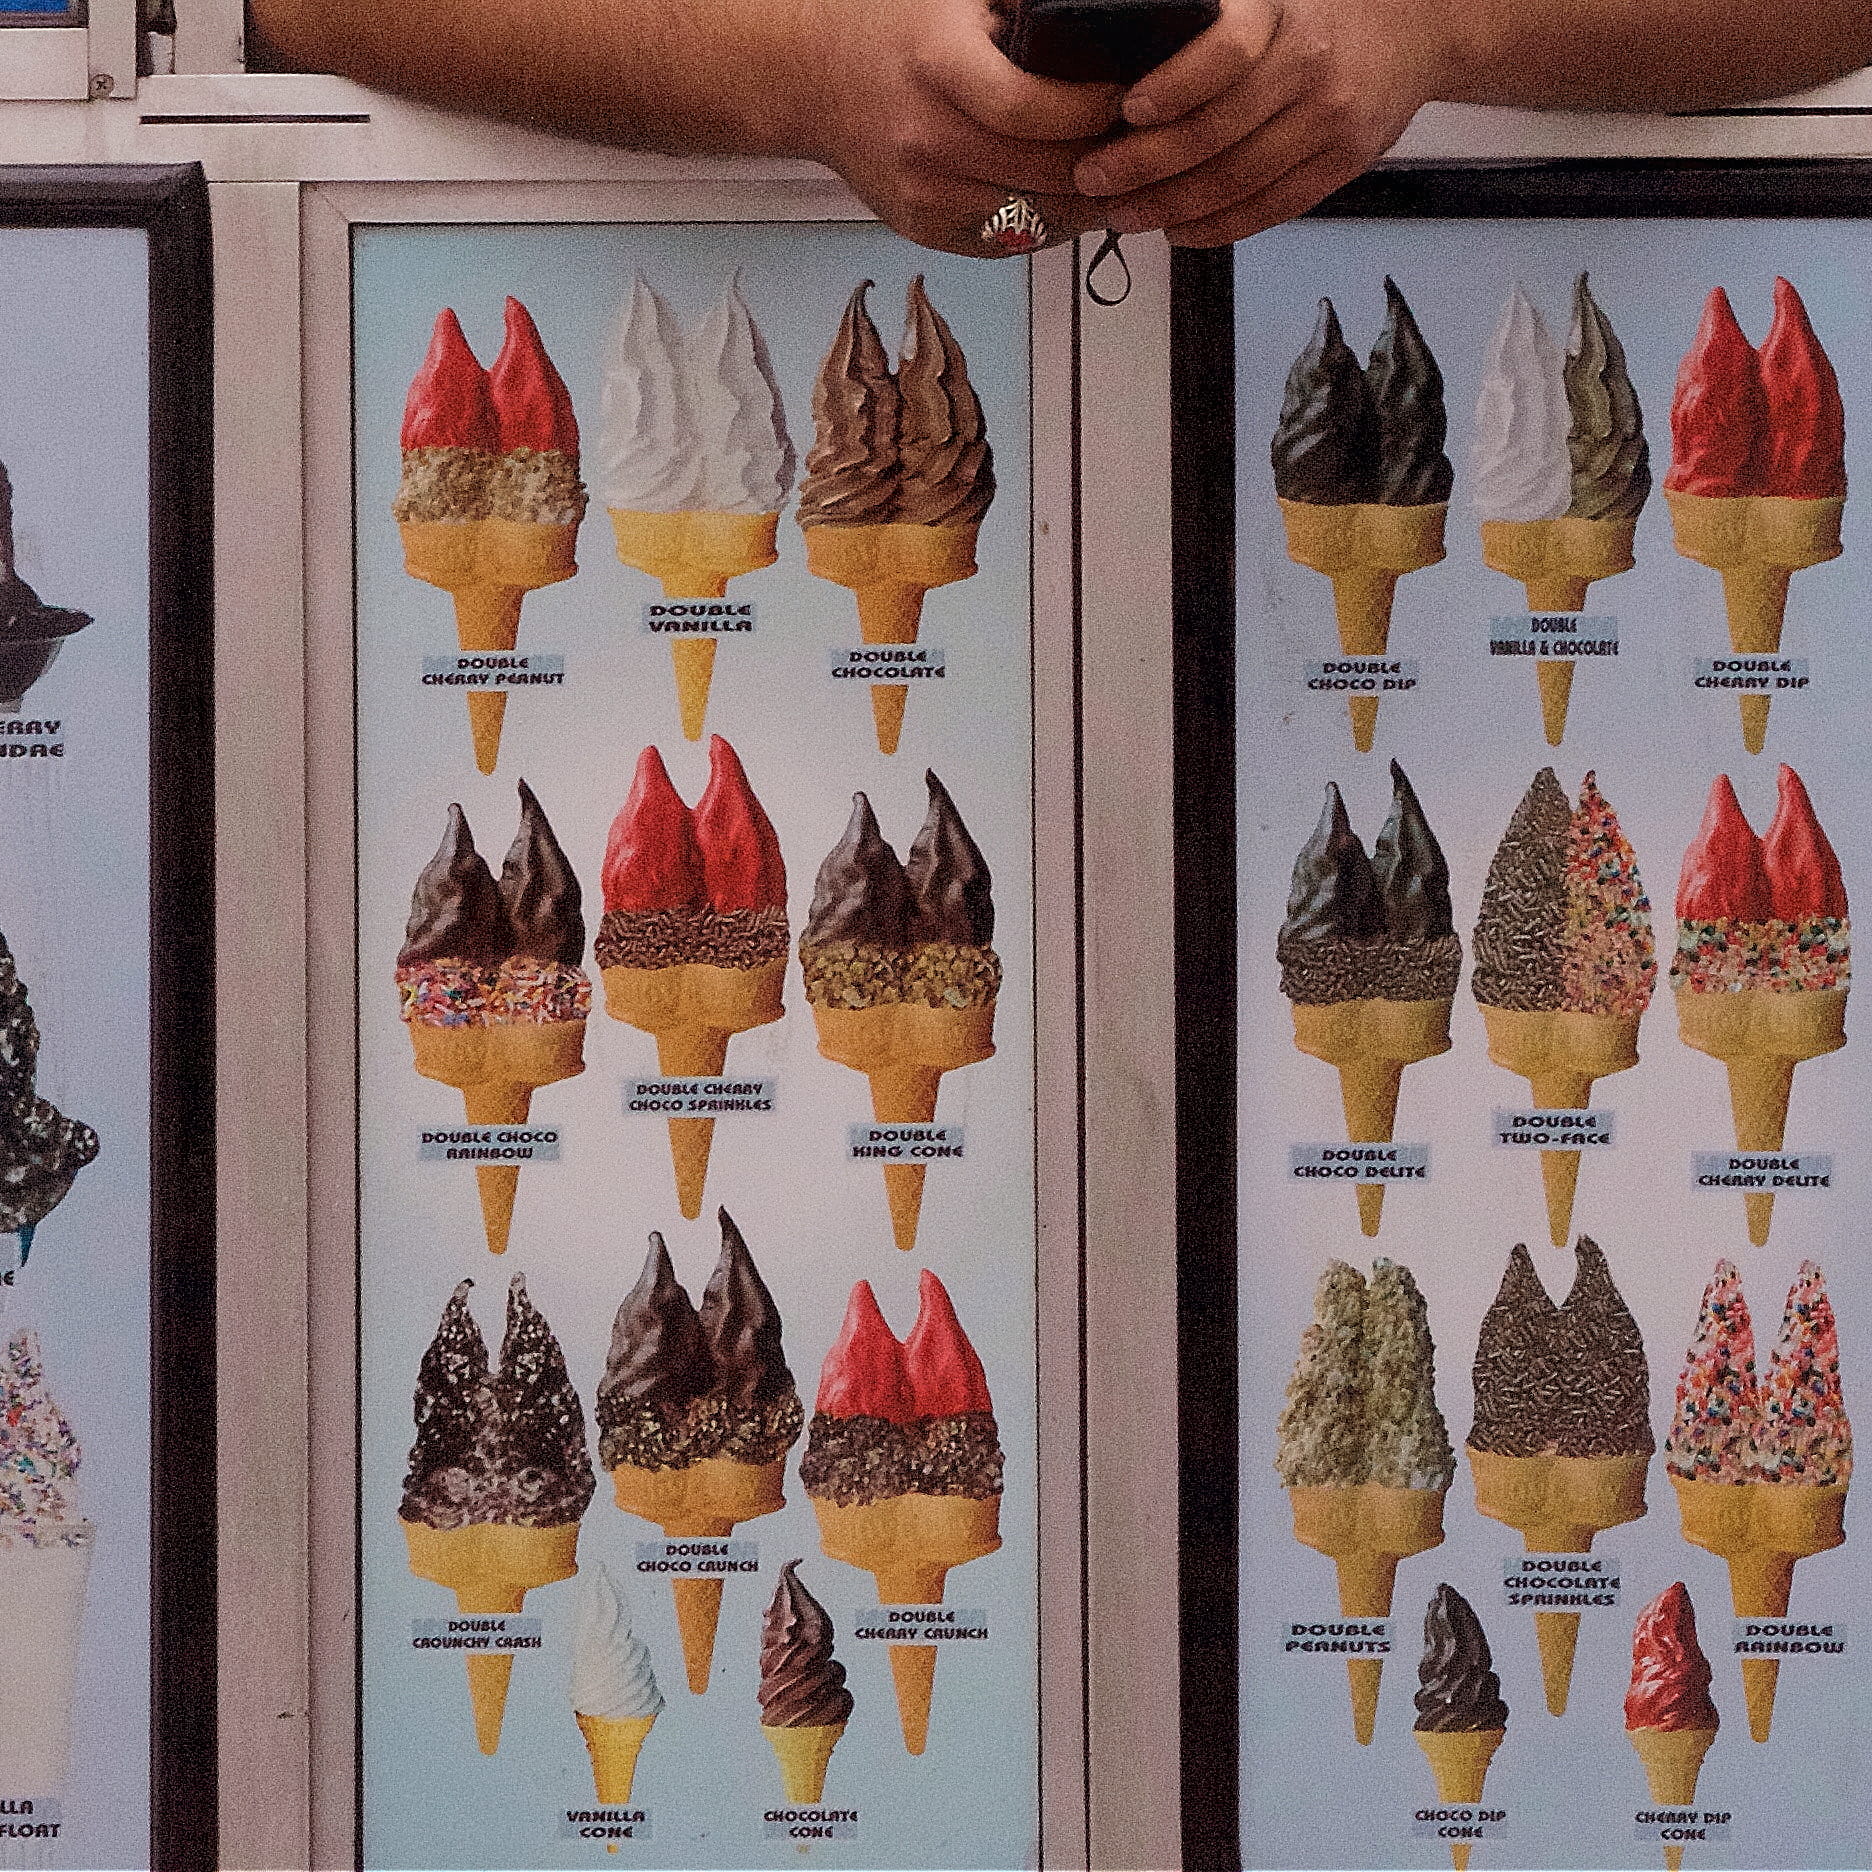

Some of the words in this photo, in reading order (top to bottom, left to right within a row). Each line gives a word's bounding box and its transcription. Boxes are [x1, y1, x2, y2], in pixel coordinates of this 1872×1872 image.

[650, 604, 751, 618] DOUBLE
[650, 619, 752, 632] VANILLA
[457, 657, 529, 669] DOUBLE
[850, 650, 927, 663] DOUBLE
[832, 666, 945, 679] CHOCOLATE
[1324, 661, 1401, 674] DOUBLE
[422, 673, 488, 685] CHERRY
[495, 673, 564, 685] PEANUT
[1308, 677, 1374, 690] CHOCO
[1382, 677, 1417, 690] DIP
[1513, 1116, 1596, 1128] DOUBLE
[422, 1131, 490, 1144] DOUBLE
[496, 1131, 558, 1144] CHOCO
[869, 1129, 946, 1142] DOUBLE
[1500, 1132, 1610, 1145] TWO-FACE
[446, 1147, 533, 1160] RAINBOW
[853, 1146, 906, 1159] KING
[913, 1146, 963, 1159] CONE
[1729, 1158, 1800, 1171] DOUBLE
[1699, 1174, 1766, 1187] CHERRY
[1774, 1174, 1829, 1187] DELITE
[888, 1611, 955, 1624] DOUBLE
[855, 1627, 919, 1639] CHERRY
[926, 1626, 988, 1639] CRUNCH
[1292, 1624, 1385, 1637] DOUBLE
[1746, 1624, 1833, 1637] DOUBLE
[1285, 1640, 1390, 1653] PEANUTS
[1734, 1640, 1844, 1653] RAINBOW
[567, 1810, 645, 1823] VANILLA
[1636, 1811, 1699, 1824] CHERRY
[1704, 1811, 1731, 1825] DIP
[580, 1827, 632, 1839] CONE
[1661, 1829, 1706, 1841] CONE
